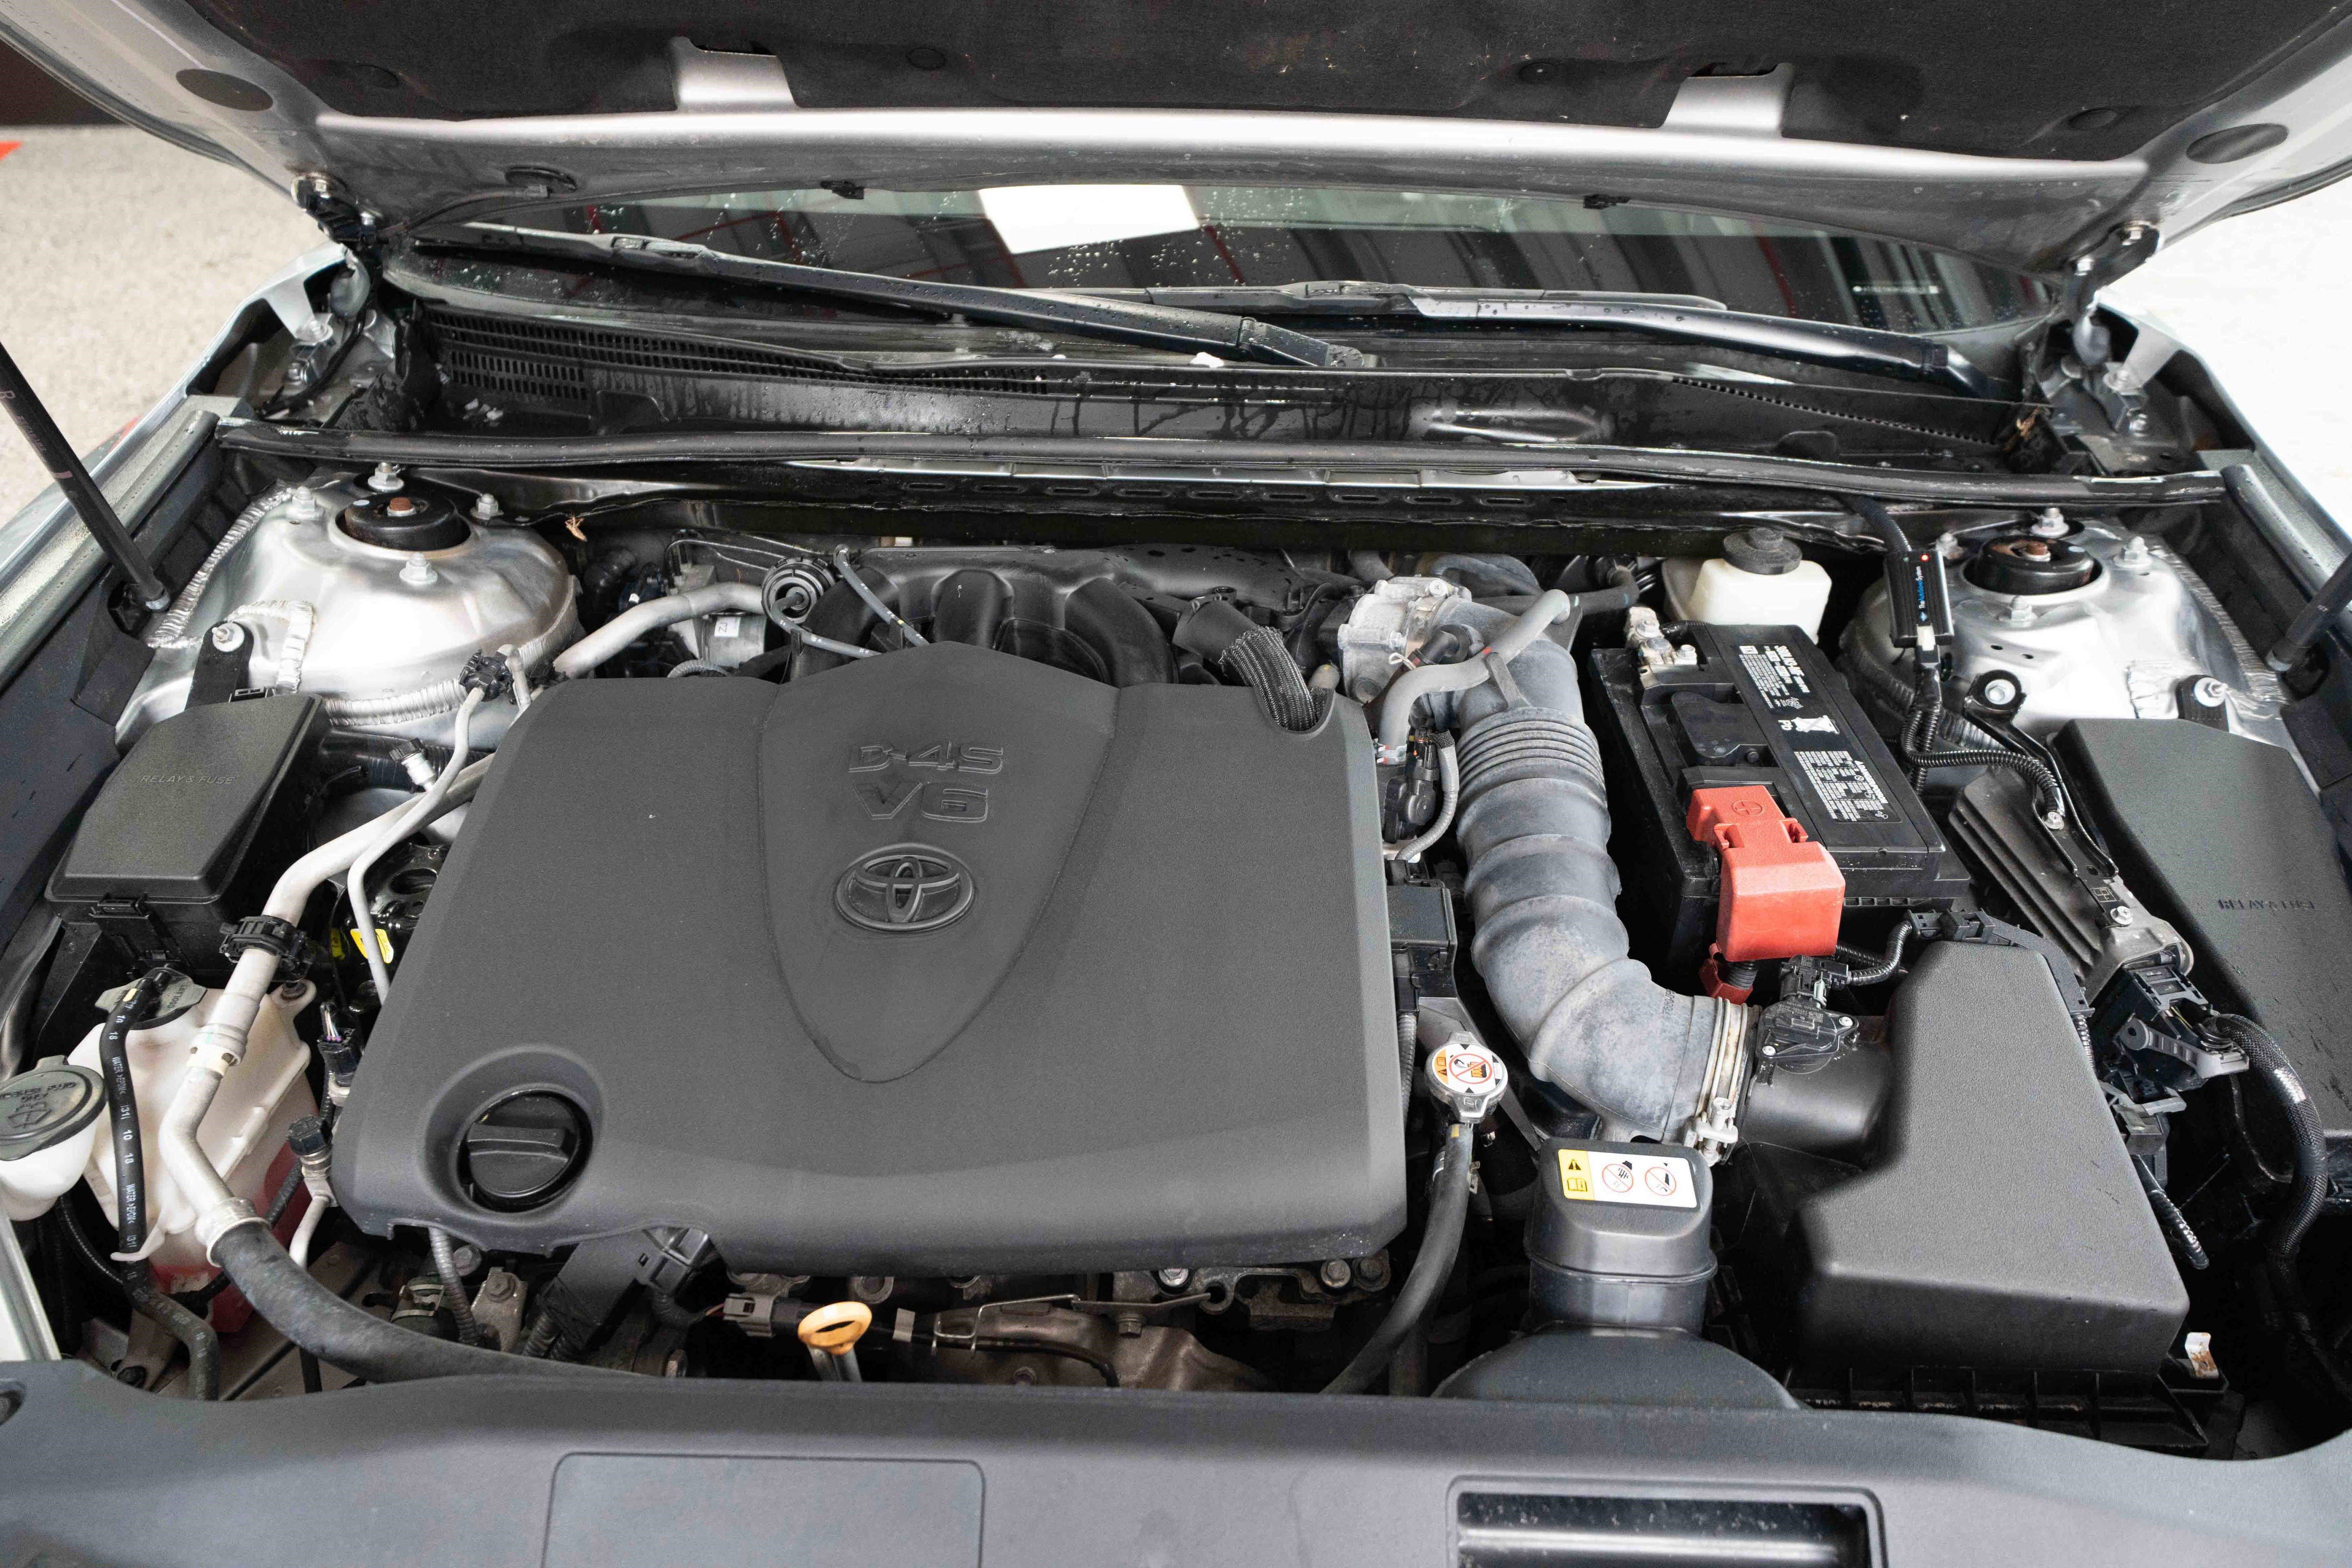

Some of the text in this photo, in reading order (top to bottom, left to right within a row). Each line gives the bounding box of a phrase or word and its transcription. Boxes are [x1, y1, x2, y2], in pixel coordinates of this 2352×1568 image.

[1778, 719, 1793, 731] Pb
[849, 741, 1003, 775] D-4S
[198, 776, 236, 784] FUSE
[854, 780, 989, 822] V6
[2218, 899, 2264, 910] RELAY
[109, 1031, 118, 1040] 18
[112, 1056, 124, 1074] WATER
[123, 1129, 133, 1140] 10
[125, 1153, 134, 1164] 18
[126, 1184, 136, 1202] WATER
